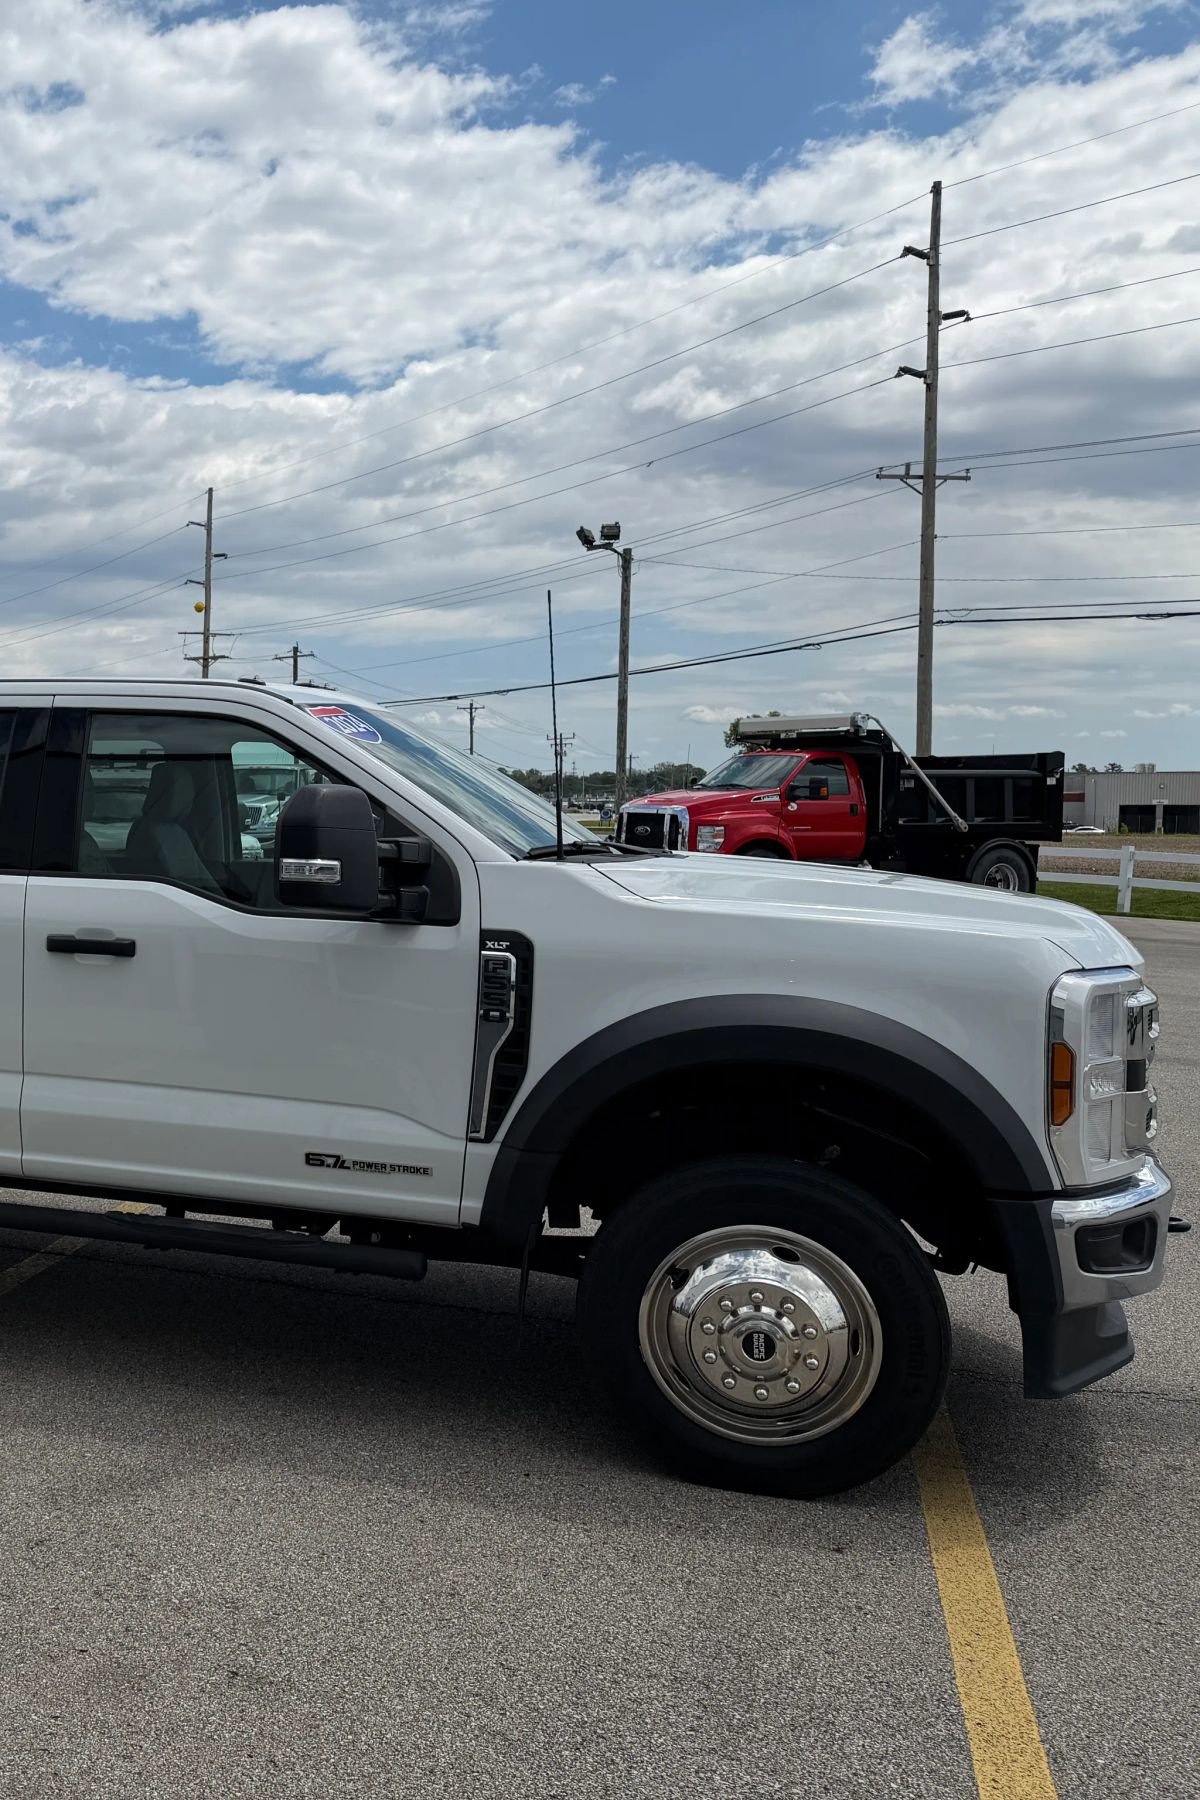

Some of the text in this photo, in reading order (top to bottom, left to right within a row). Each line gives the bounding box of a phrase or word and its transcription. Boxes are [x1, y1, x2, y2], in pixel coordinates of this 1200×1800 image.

[323, 715, 373, 734] 2024
[484, 940, 510, 949] XLT
[305, 1152, 351, 1170] 6.7L
[352, 1160, 387, 1171] POWER
[389, 1164, 430, 1176] STROKE
[758, 1333, 766, 1360] PACIFIC
